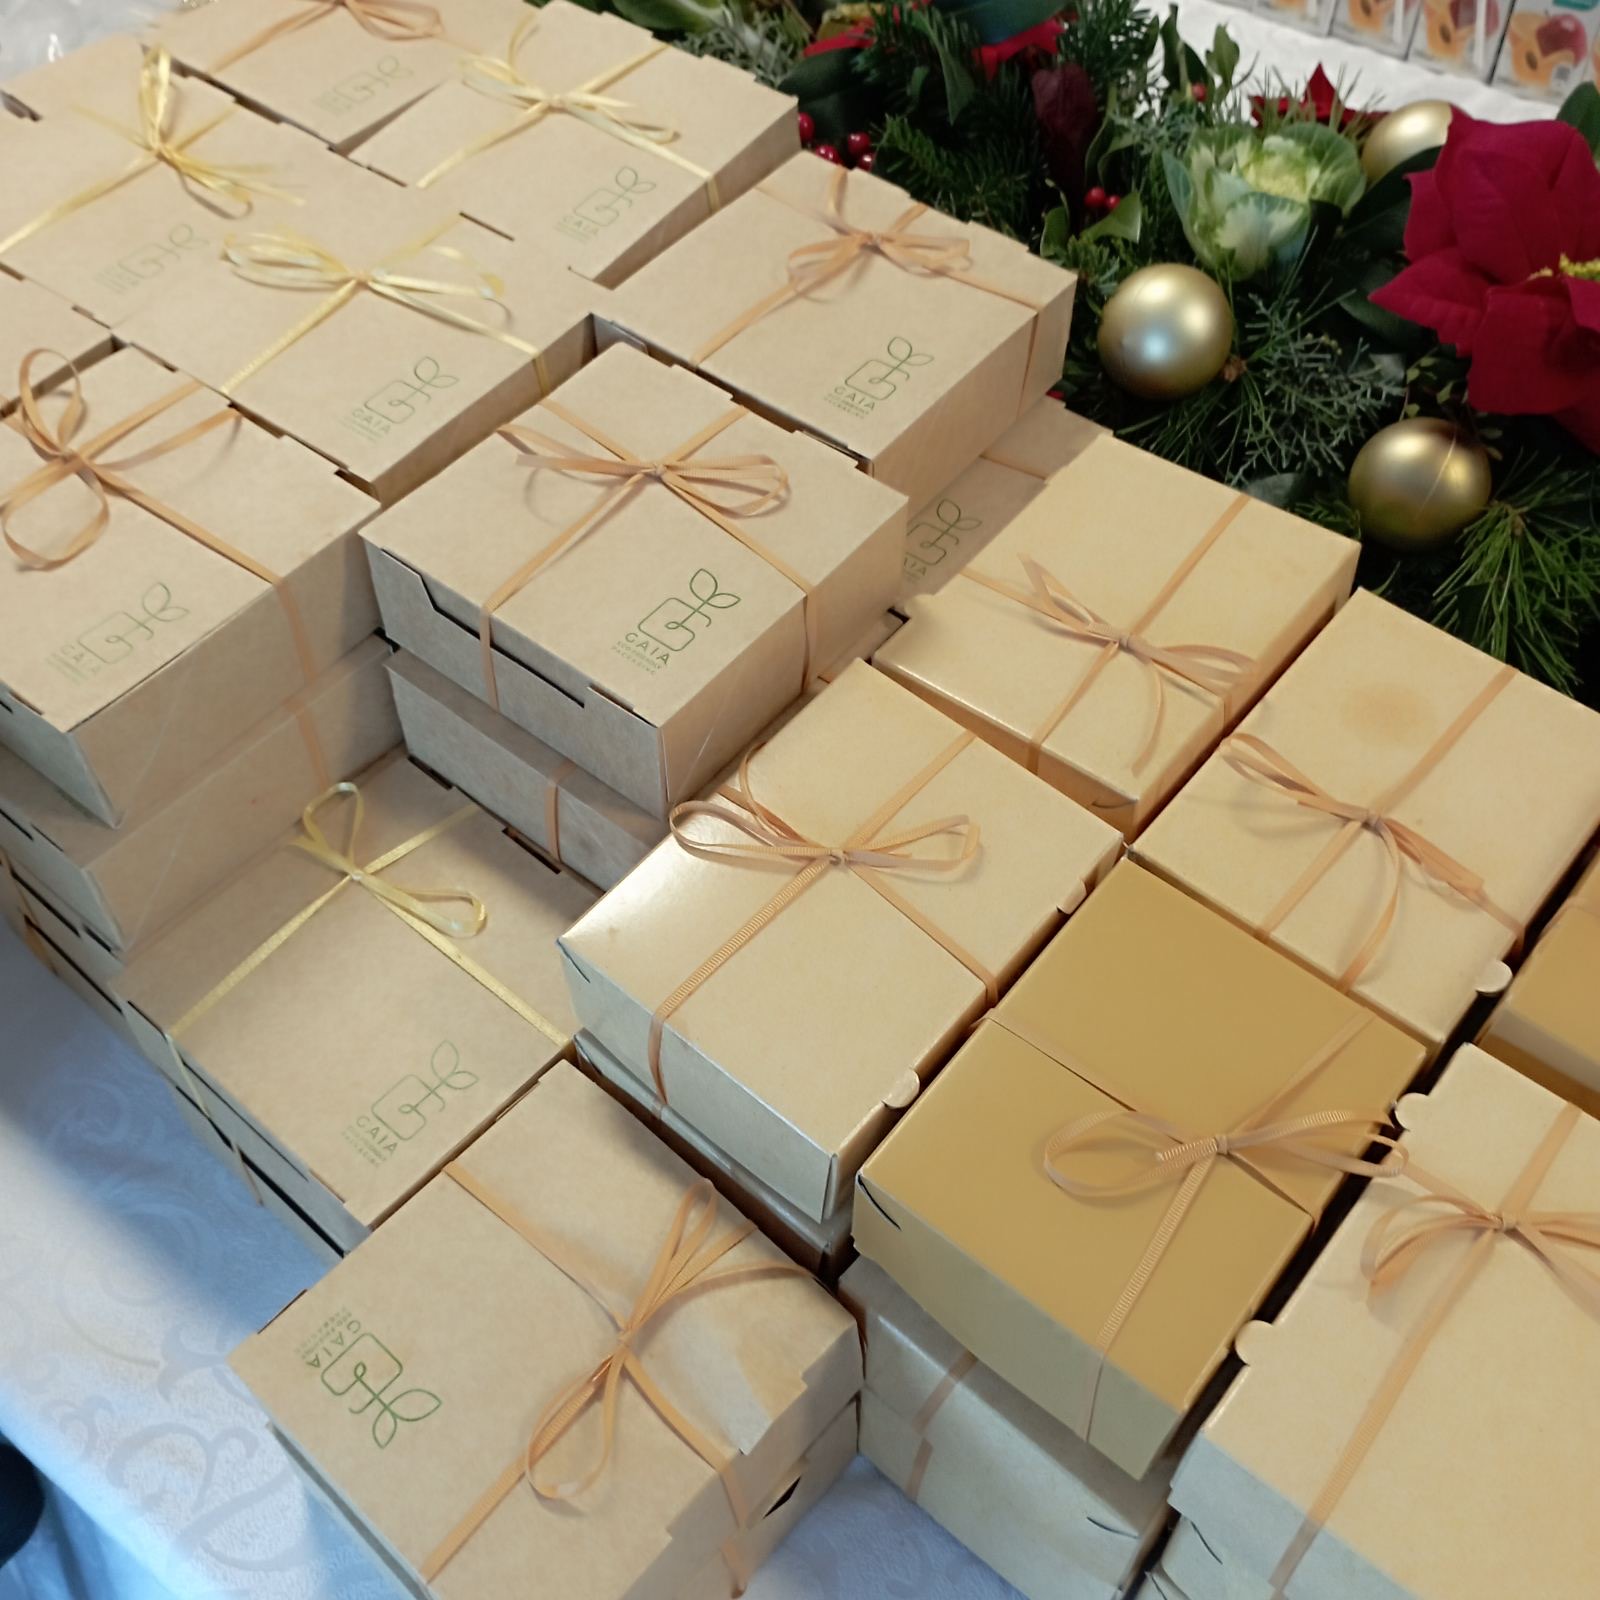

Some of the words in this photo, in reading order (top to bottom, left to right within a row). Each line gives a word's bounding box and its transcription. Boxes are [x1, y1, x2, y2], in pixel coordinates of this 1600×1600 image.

[624, 632, 670, 665] GAIA
[355, 1115, 398, 1157] GAIA
[305, 1319, 362, 1369] GAIA
